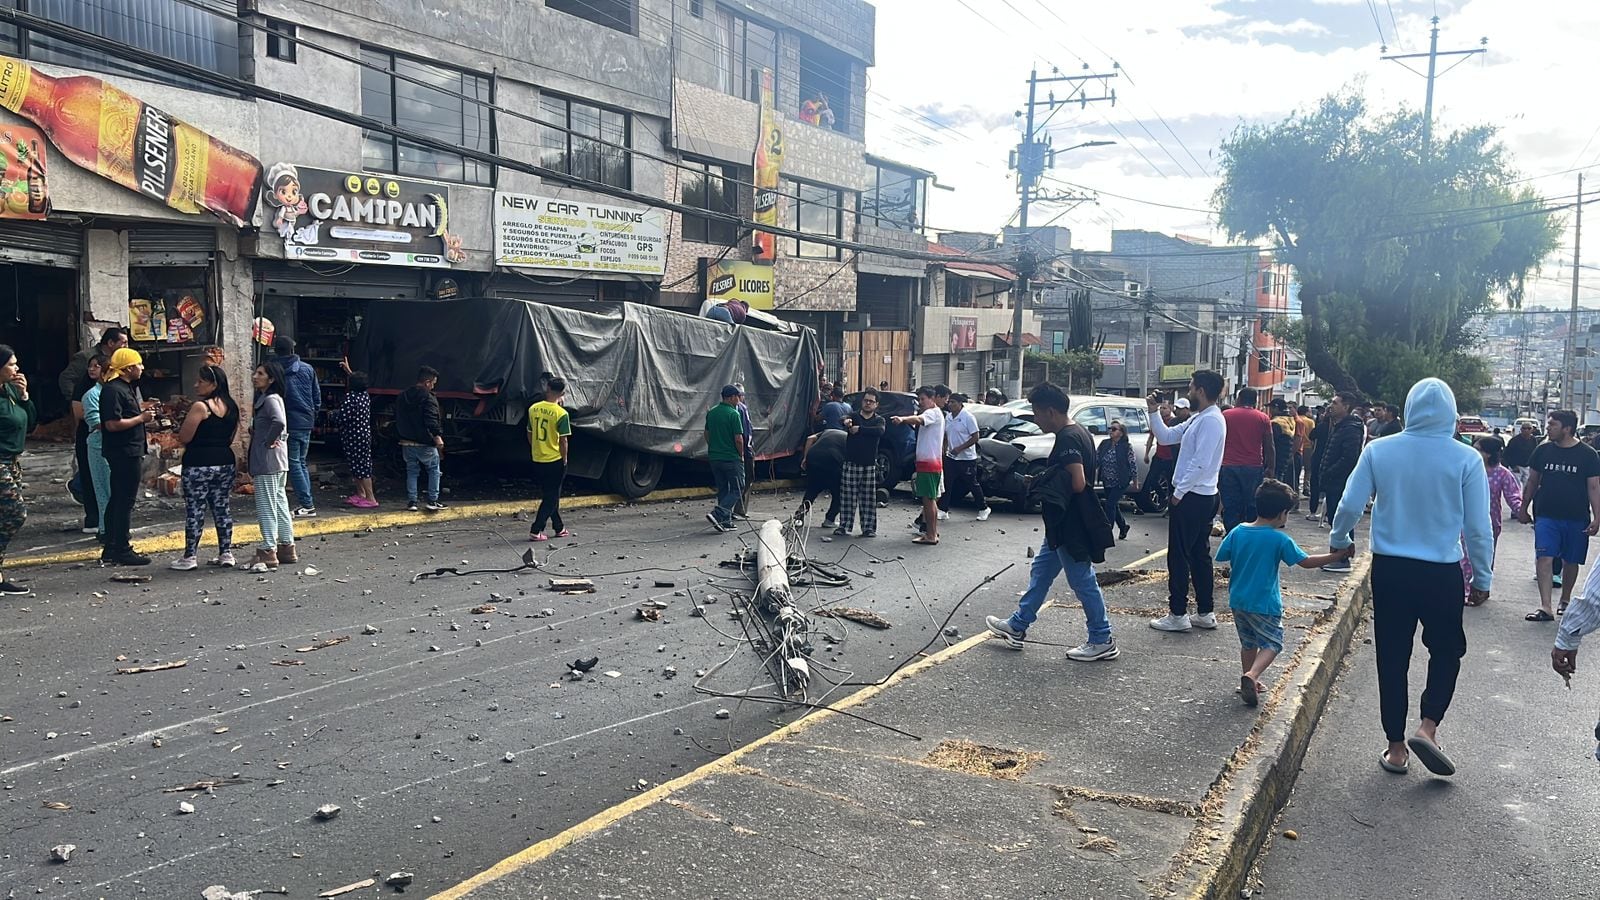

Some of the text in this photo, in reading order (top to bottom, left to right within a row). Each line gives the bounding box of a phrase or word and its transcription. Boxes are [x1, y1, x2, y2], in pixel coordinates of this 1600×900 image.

[0, 62, 14, 93] LITRO
[142, 106, 169, 200] PILSENER
[308, 193, 436, 228] CAMIPAN
[502, 195, 643, 223] NEW CAR TUNNING
[502, 221, 533, 229] ARREGLO
[550, 232, 577, 240] PUERTAS
[600, 231, 630, 241] CINTURONES
[637, 235, 662, 243] SEGURIDAD
[534, 238, 572, 246] ELECTRICOS
[636, 242, 653, 252] GPS
[502, 249, 543, 257] ELECTRICOS
[549, 252, 582, 260] MANUALES
[600, 247, 616, 255] FOCOS
[600, 255, 622, 263] ESPEJOS
[712, 277, 770, 293] PILSENER LICORES
[535, 416, 549, 441] 15
